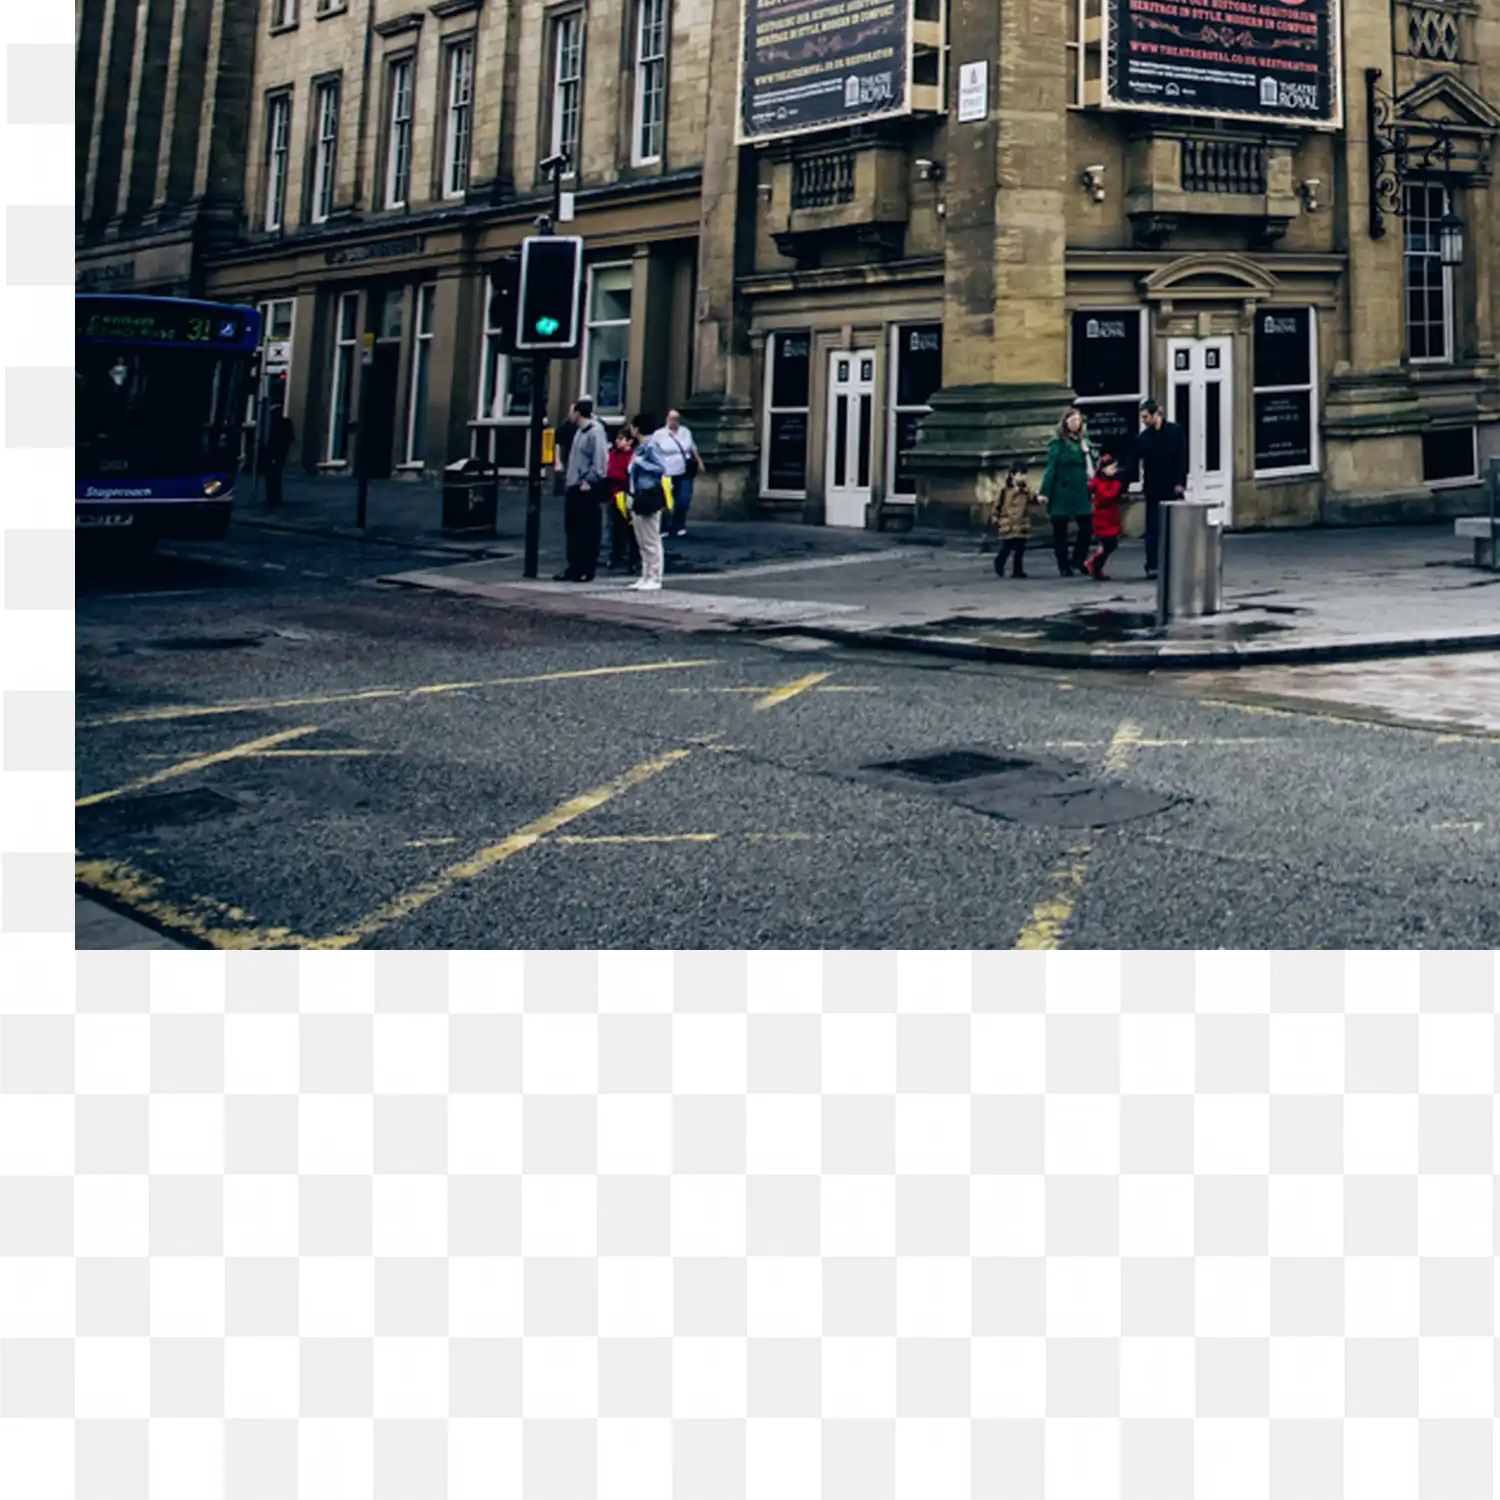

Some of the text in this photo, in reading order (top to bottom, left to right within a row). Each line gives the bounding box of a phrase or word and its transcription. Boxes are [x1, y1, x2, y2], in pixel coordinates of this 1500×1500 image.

[1129, 0, 1177, 15] HERITAGE
[1179, 6, 1190, 17] IN
[1225, 14, 1263, 28] MODERN
[1265, 20, 1275, 30] IN
[1276, 21, 1318, 36] COMFORT
[1259, 5, 1317, 23] AUDITORIUM
[861, 83, 893, 103] ROYAL
[1279, 81, 1317, 96] THEATRE
[1279, 92, 1319, 110] ROYAL
[85, 486, 152, 499] Stagecoach
